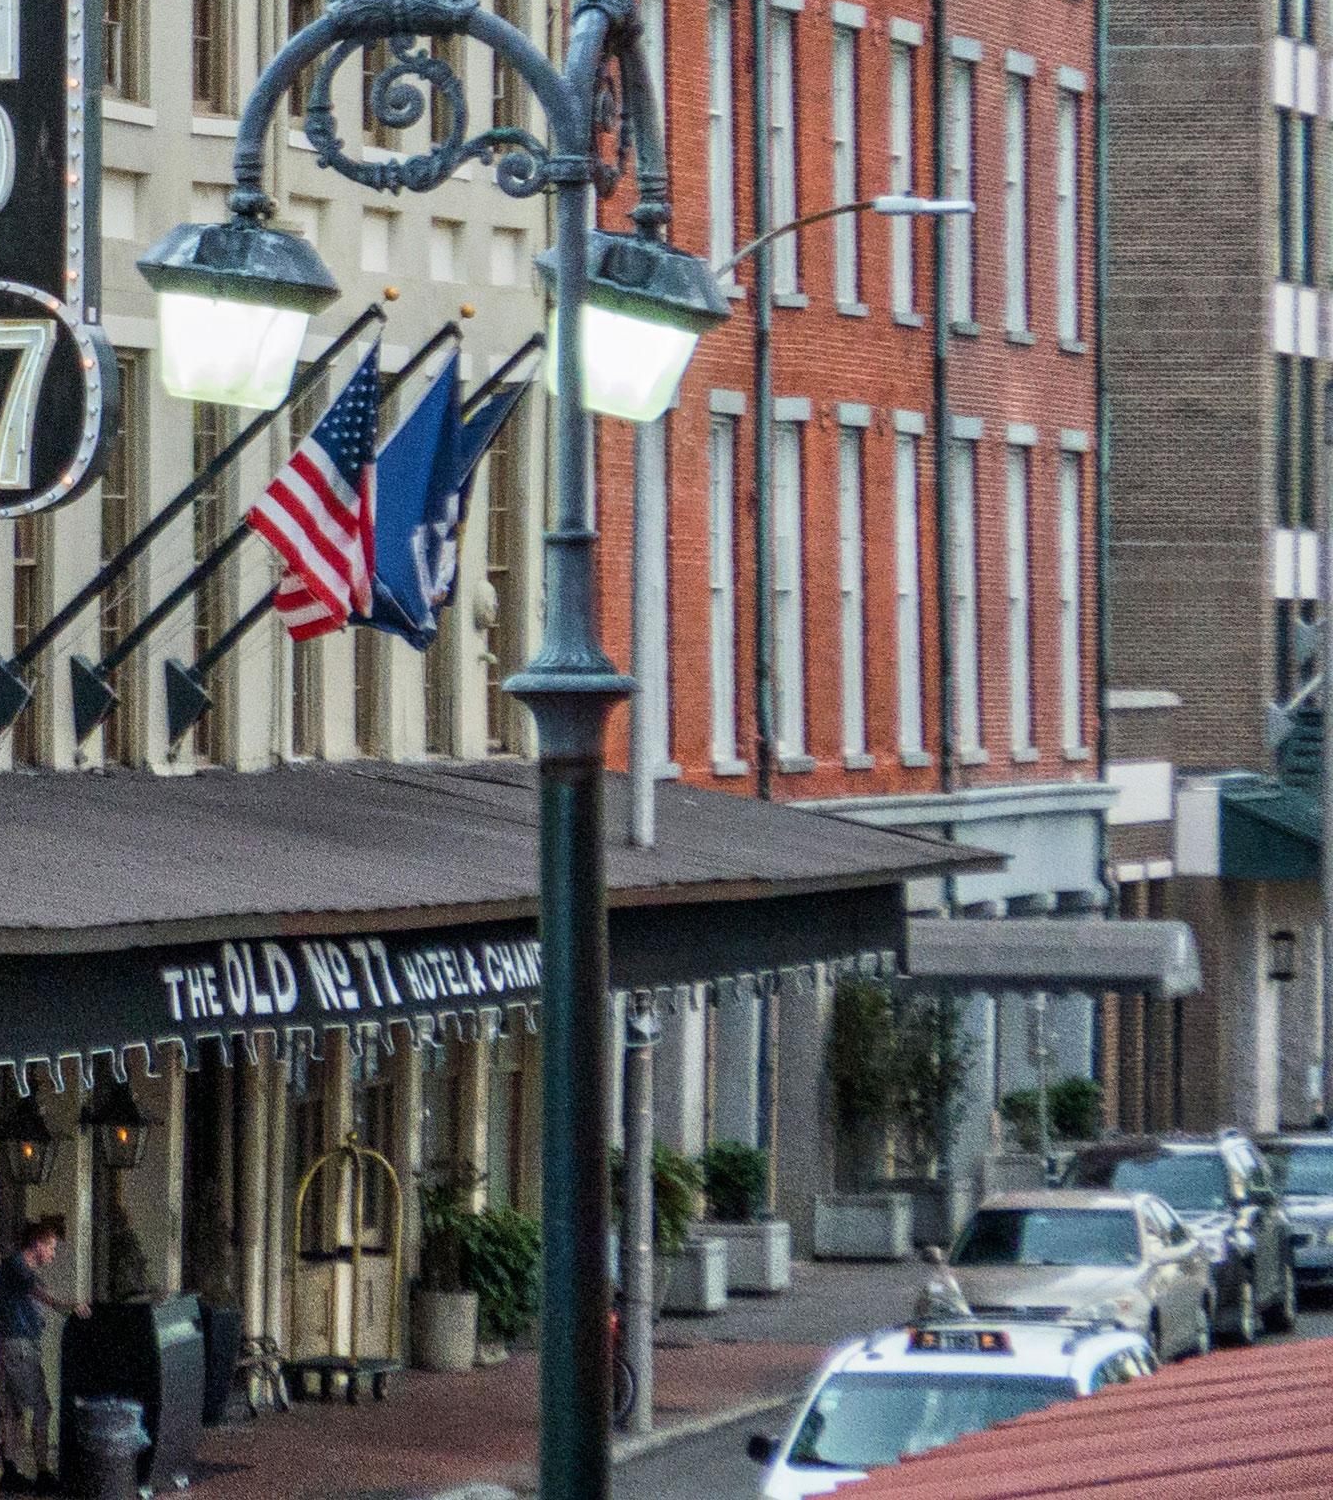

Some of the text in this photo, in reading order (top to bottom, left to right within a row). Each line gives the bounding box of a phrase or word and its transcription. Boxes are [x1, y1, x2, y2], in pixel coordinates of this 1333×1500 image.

[162, 965, 224, 1020] THE
[220, 941, 298, 1017] OLD
[348, 937, 402, 1006] 77
[400, 947, 471, 1001] HOTEL
[463, 947, 487, 996] &
